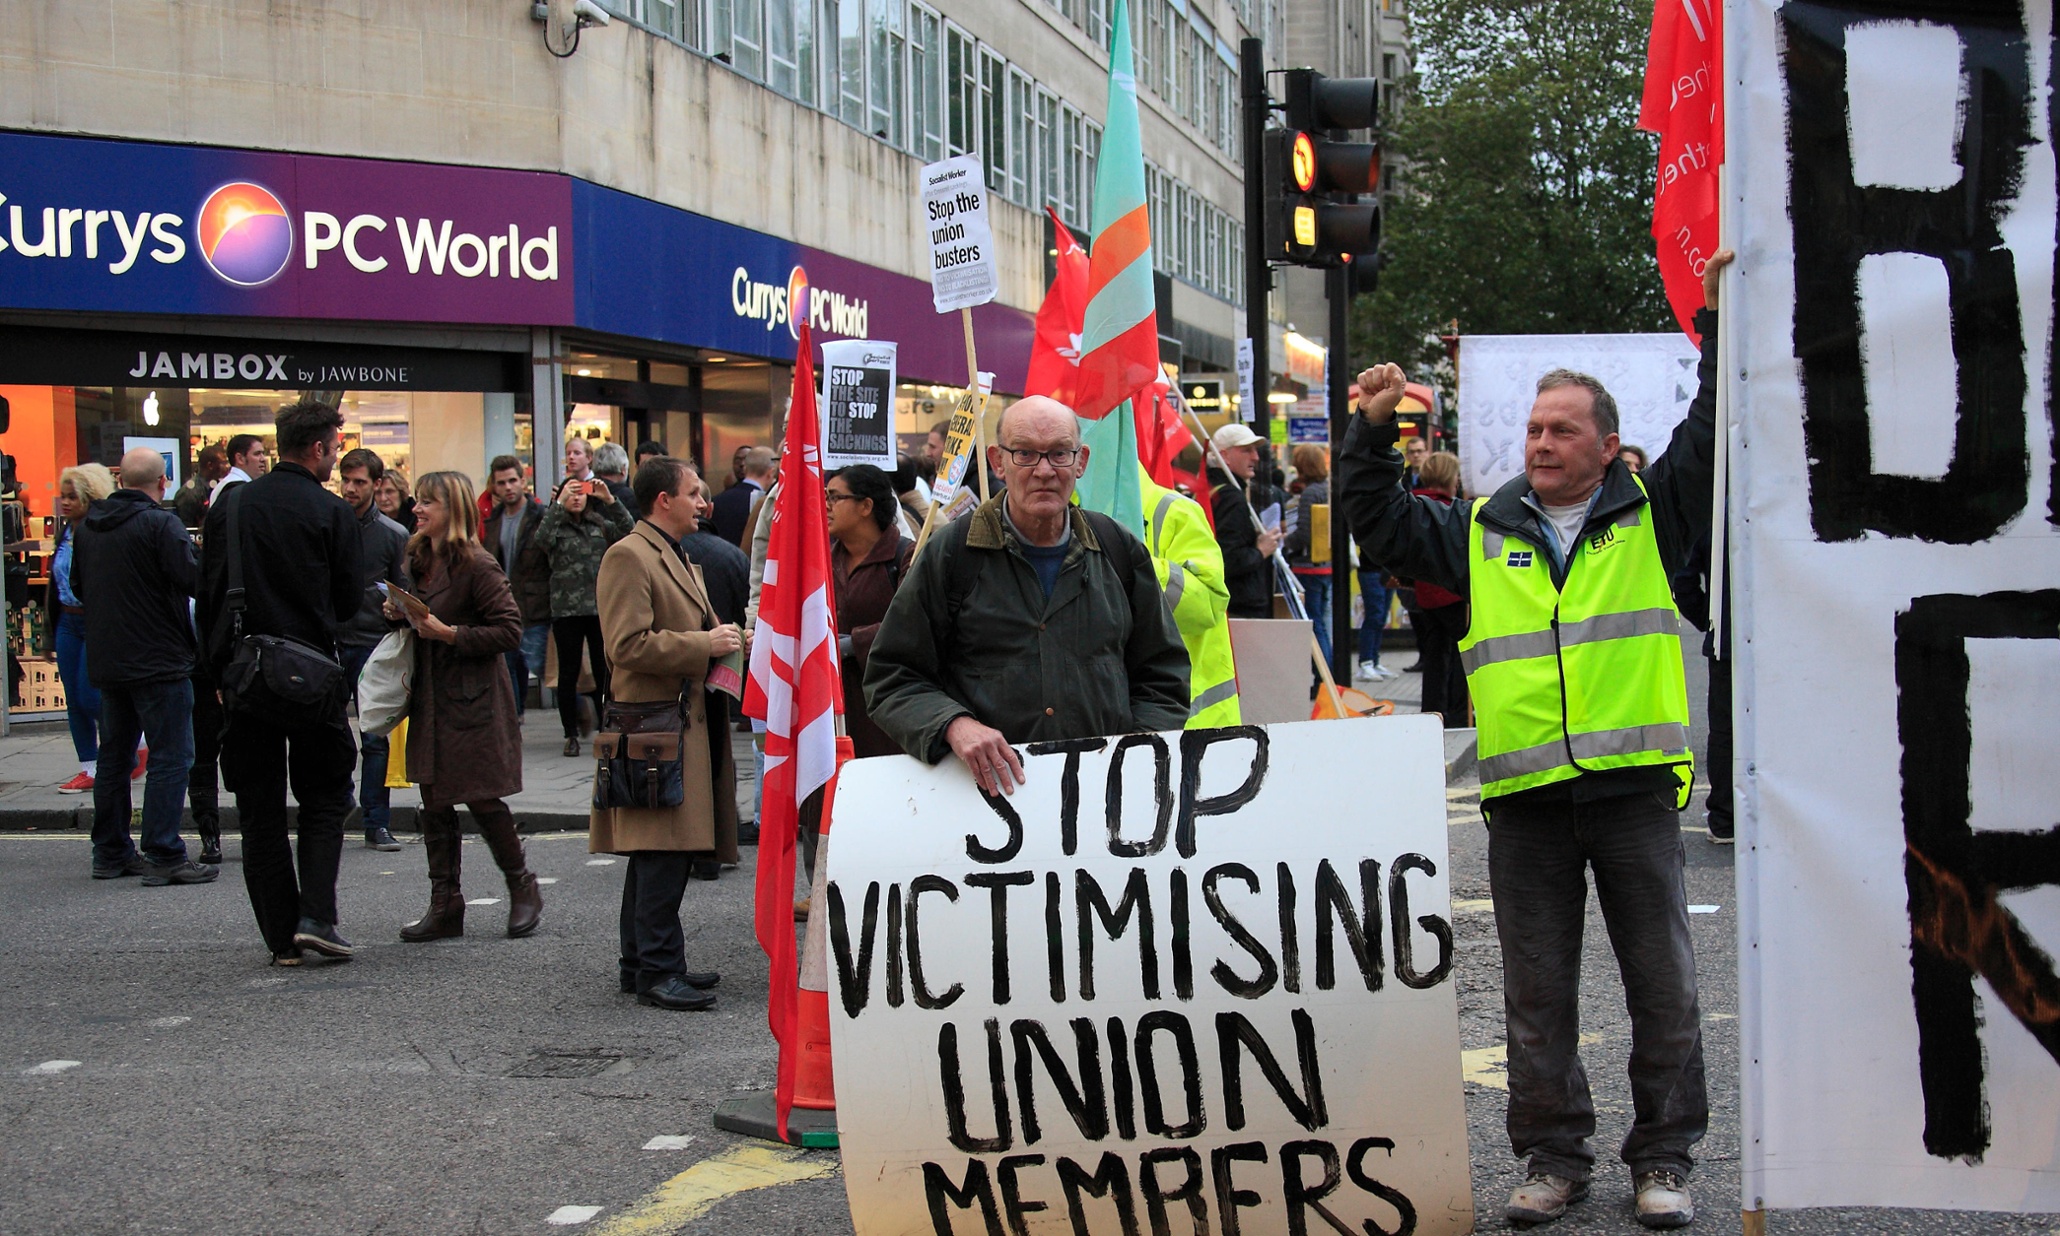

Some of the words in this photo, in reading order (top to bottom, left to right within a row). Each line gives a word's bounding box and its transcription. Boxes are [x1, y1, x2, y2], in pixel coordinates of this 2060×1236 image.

[928, 172, 948, 186] Socialist
[947, 168, 967, 180] Worker
[928, 200, 955, 221] Stop
[956, 192, 980, 214] the
[0, 191, 186, 275] urrys
[304, 211, 389, 273] PC
[395, 216, 559, 281] World
[932, 222, 965, 246] union
[935, 244, 981, 270] busters
[732, 267, 787, 331] Currys
[809, 293, 831, 332] PC
[831, 298, 868, 339] World
[129, 350, 289, 382] JAMBOX
[298, 368, 316, 385] by
[319, 366, 409, 383] JAWBONE
[832, 368, 864, 386] STOP
[831, 385, 854, 402] THE
[856, 386, 879, 403] SITE
[830, 401, 847, 417] TO
[848, 402, 877, 419] STOP
[830, 417, 853, 434] THE
[829, 433, 887, 451] SACKINGS
[1591, 529, 1615, 550] ETU
[965, 724, 1270, 864] STOP
[827, 852, 1454, 1019] VICTIMISING
[938, 1007, 1328, 1154] UNION
[922, 1137, 1417, 1236] MEMBERS
